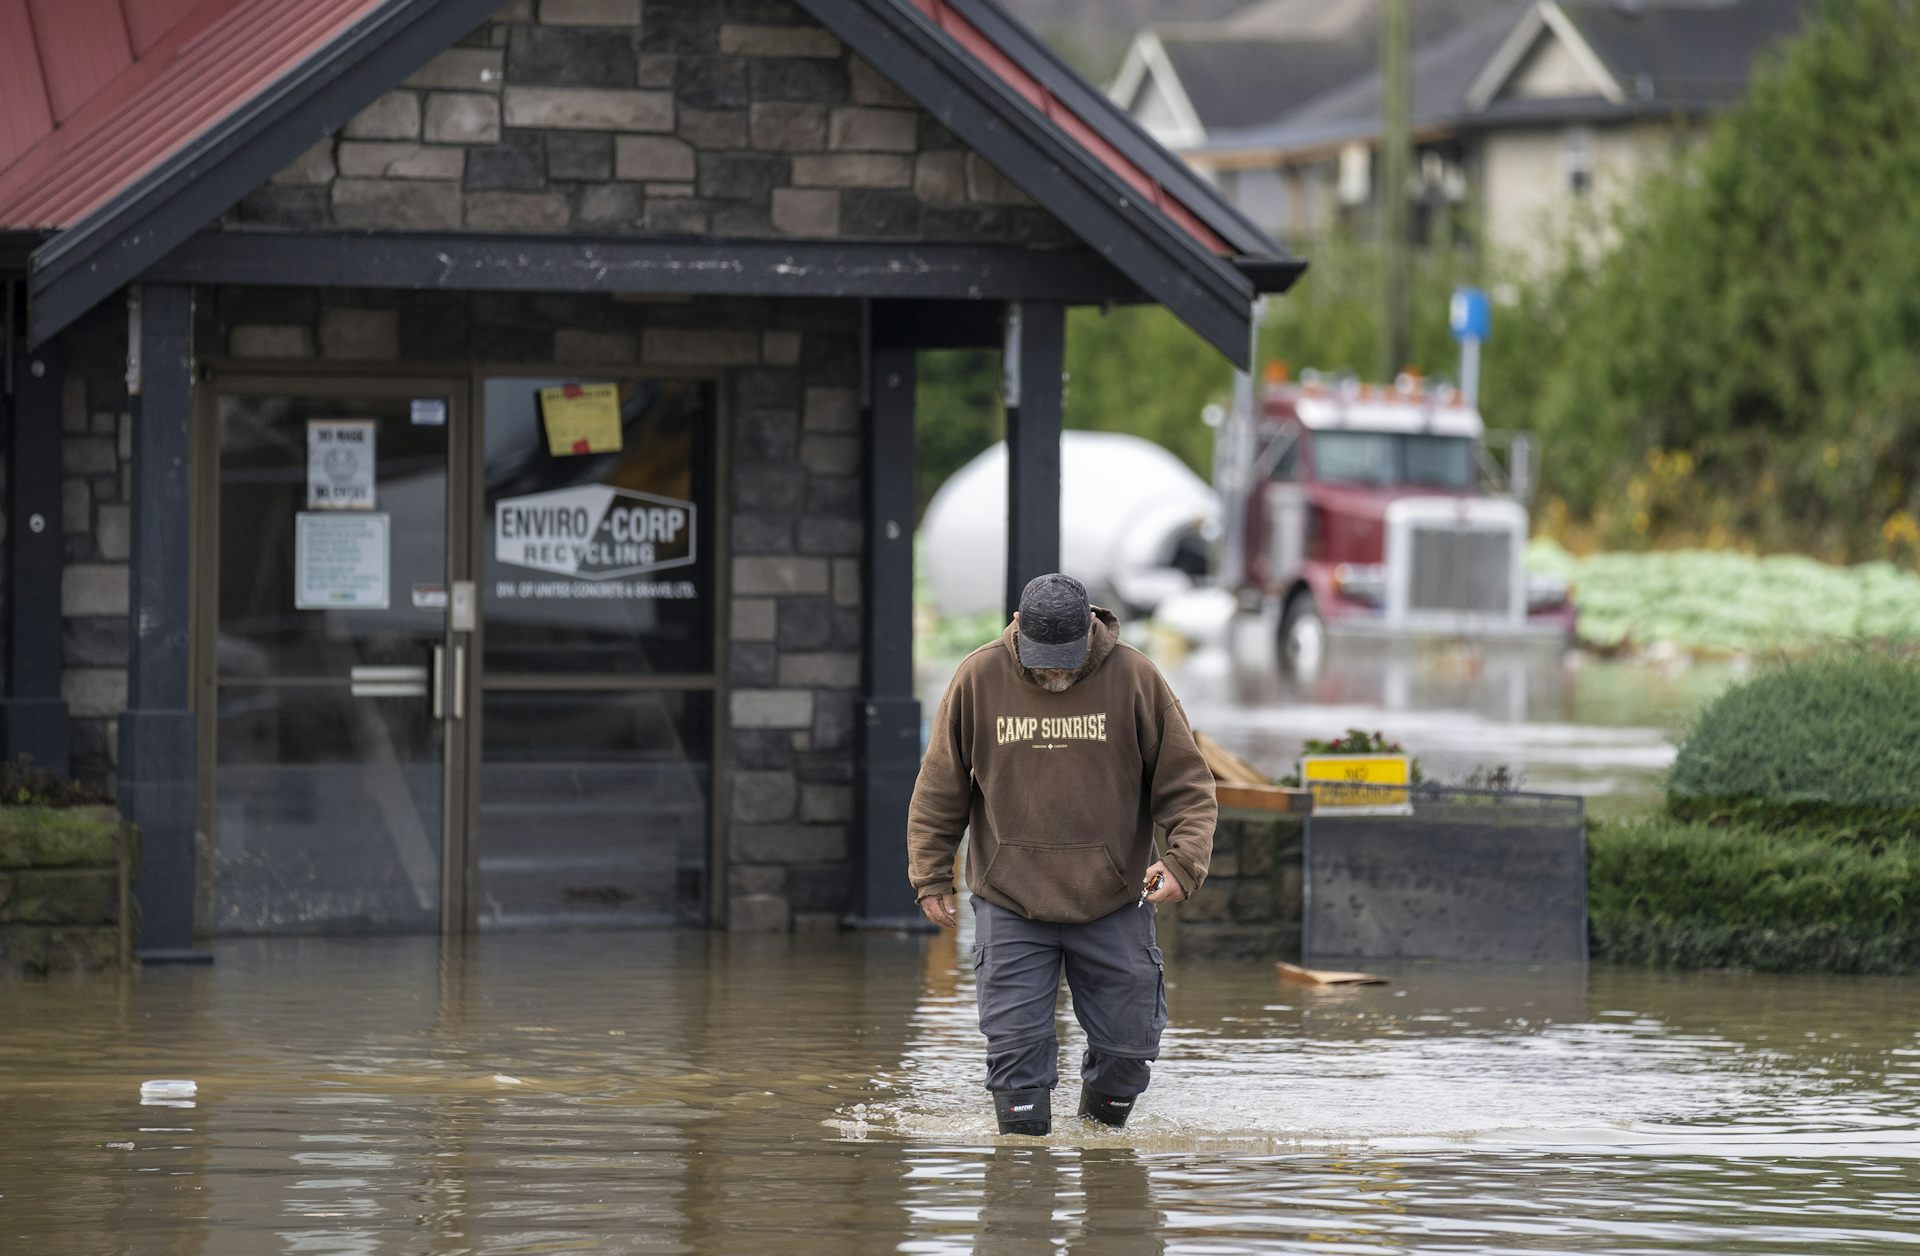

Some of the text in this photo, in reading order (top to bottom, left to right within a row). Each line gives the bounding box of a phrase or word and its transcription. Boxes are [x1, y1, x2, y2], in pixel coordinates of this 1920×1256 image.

[502, 507, 589, 538] ENVIRO
[524, 543, 656, 565] RECYCLING
[518, 582, 532, 598] OF
[534, 582, 570, 598] UNITED
[571, 582, 623, 598] CONCRETE
[634, 582, 673, 598] GRAVEL
[997, 713, 1107, 745] CAMP SUNRISE
